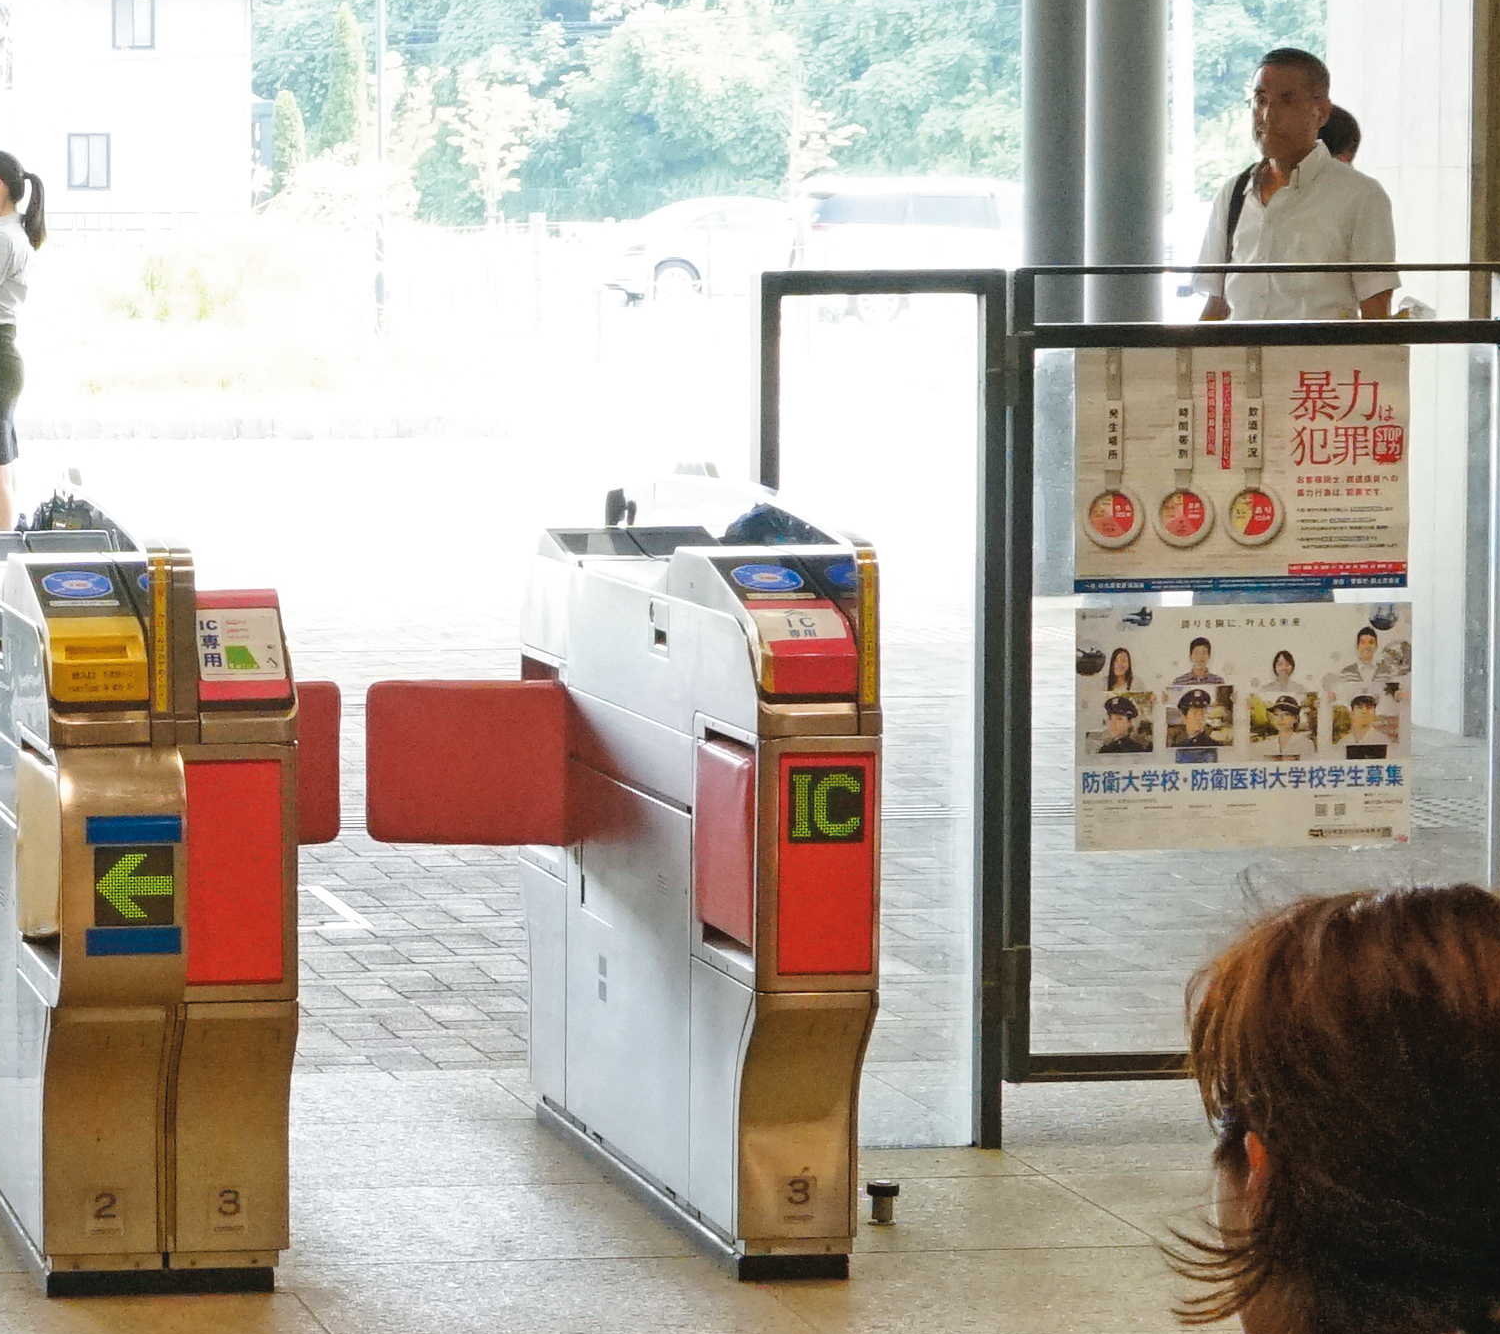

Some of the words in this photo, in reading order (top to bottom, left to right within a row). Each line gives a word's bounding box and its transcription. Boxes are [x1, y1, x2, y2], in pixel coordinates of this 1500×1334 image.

[1289, 369, 1394, 422] 暴力は
[1290, 426, 1370, 466] 犯罪
[1375, 428, 1402, 441] STOP
[792, 774, 860, 837] IC
[94, 1192, 117, 1219] 2
[217, 1189, 241, 1216] 3
[788, 1179, 810, 1205] 3
